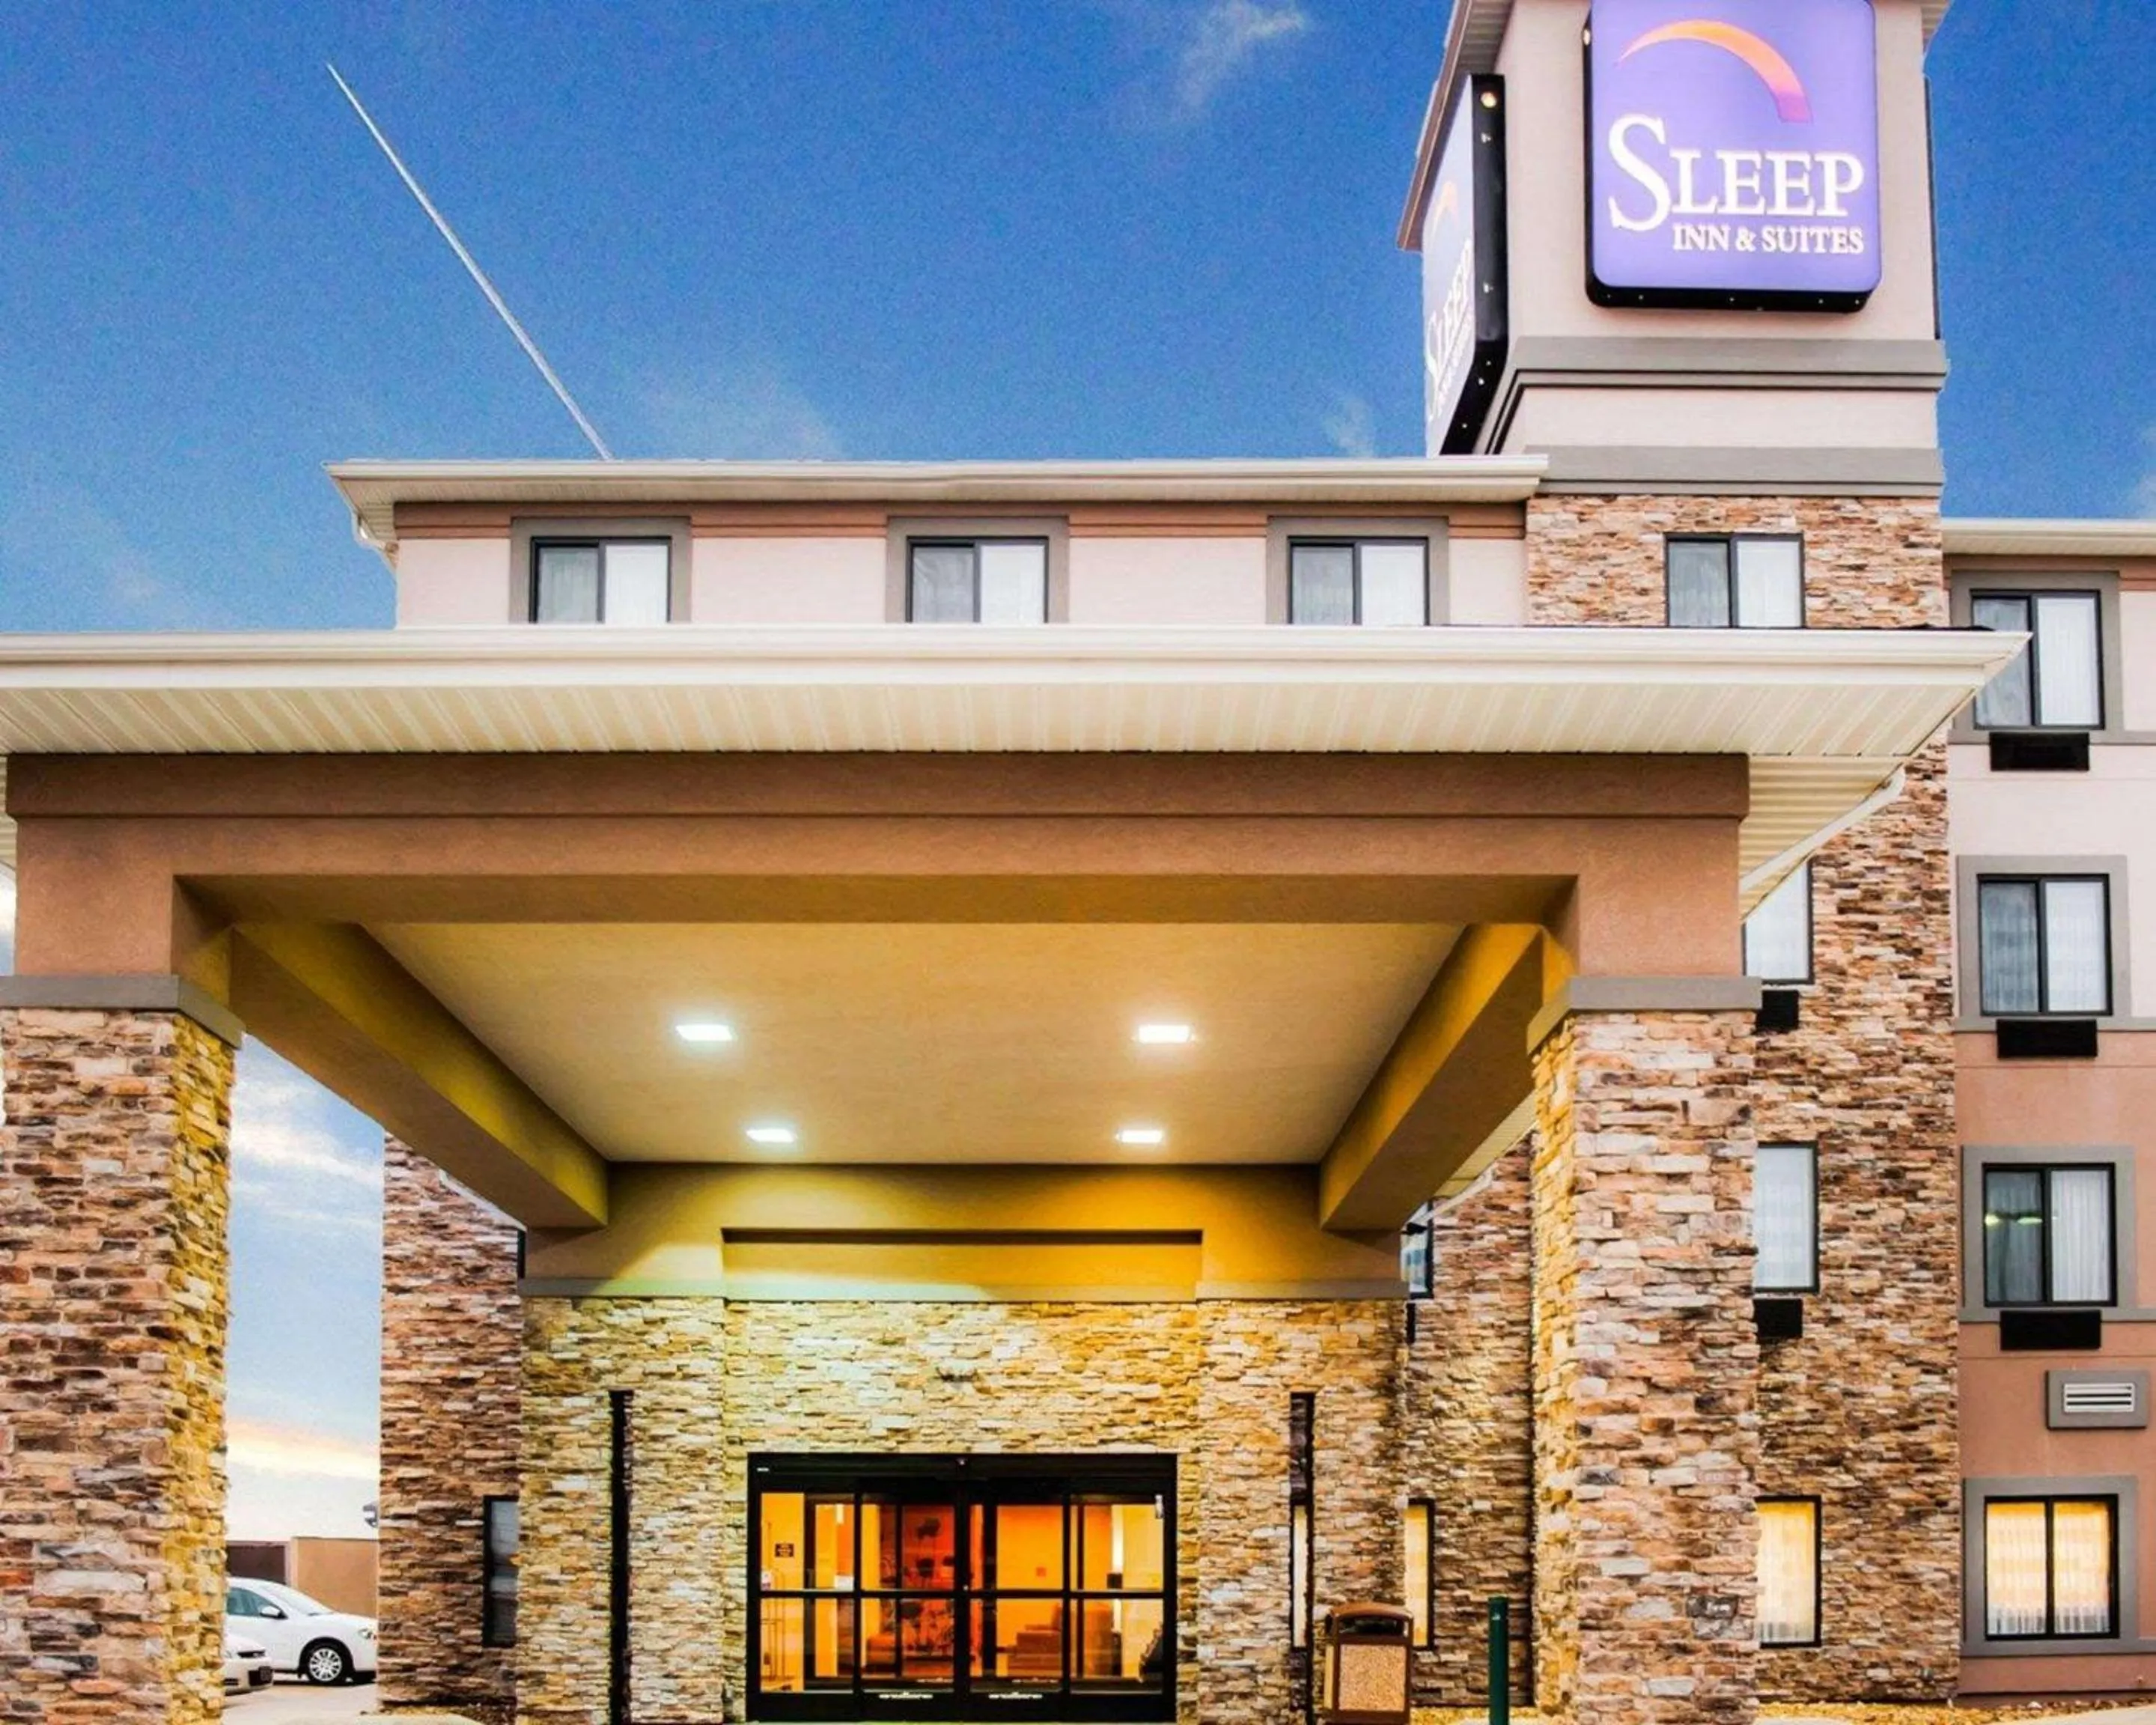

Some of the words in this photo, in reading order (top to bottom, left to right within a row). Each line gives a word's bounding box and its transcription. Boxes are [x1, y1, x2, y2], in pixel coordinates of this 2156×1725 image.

[1608, 113, 1865, 231] SLEEP
[1673, 224, 1730, 252] INN
[1735, 227, 1756, 252] &
[1761, 227, 1865, 254] SUITES
[1425, 237, 1472, 422] SLEEP
